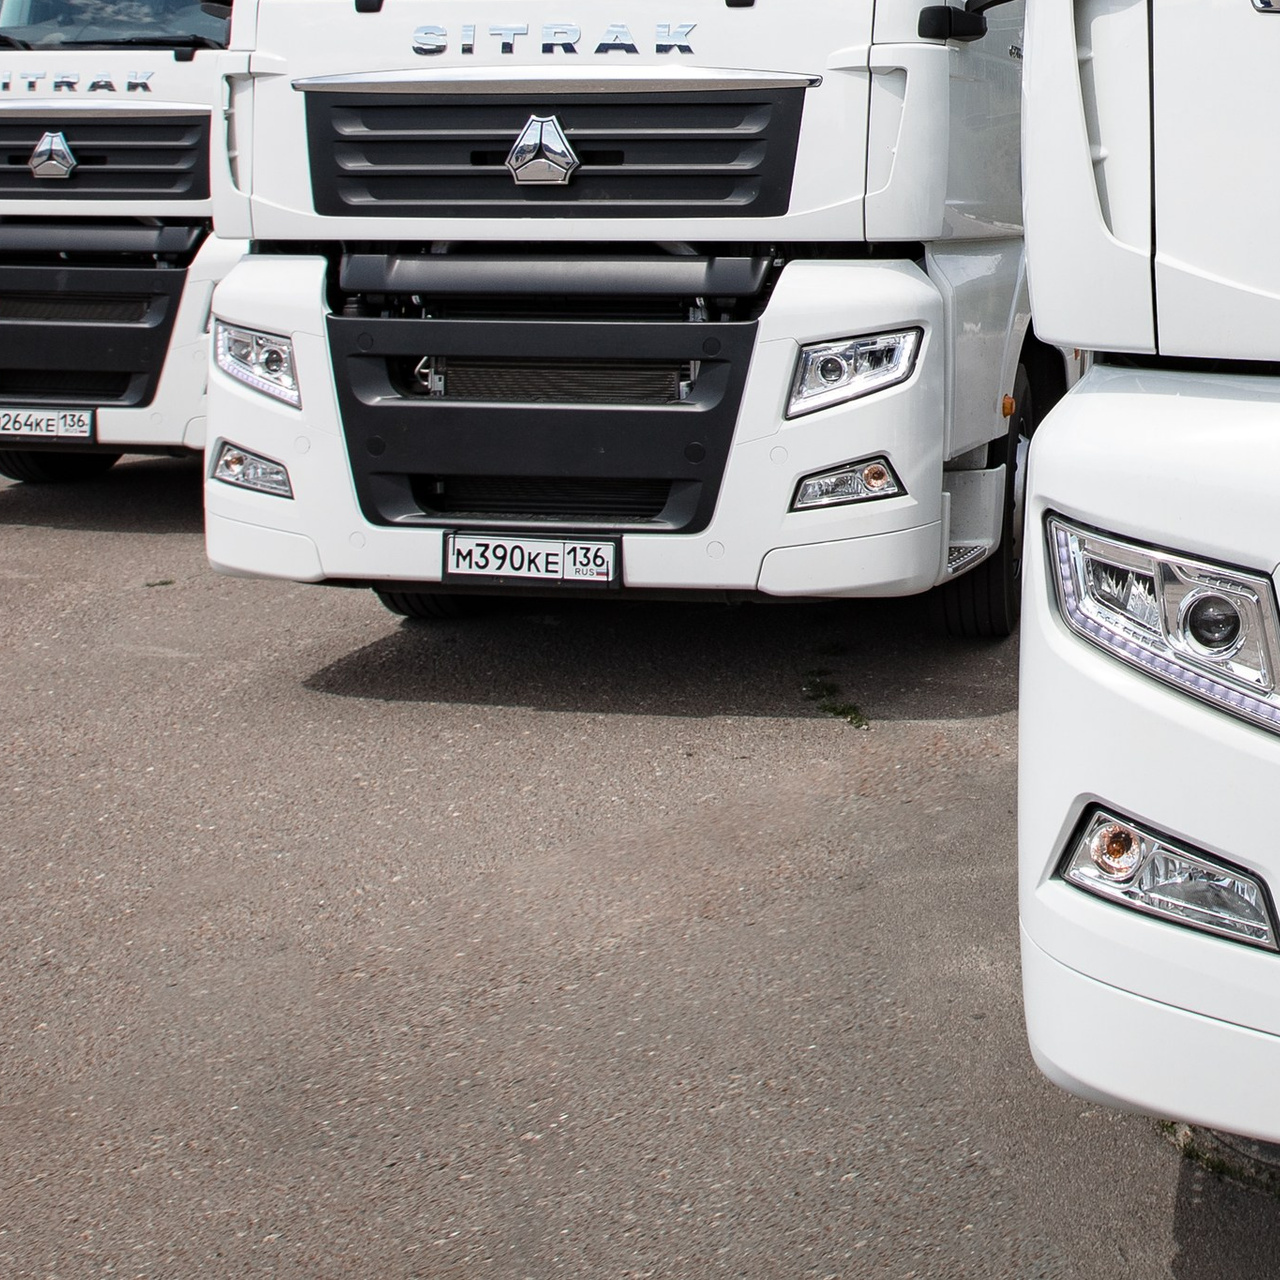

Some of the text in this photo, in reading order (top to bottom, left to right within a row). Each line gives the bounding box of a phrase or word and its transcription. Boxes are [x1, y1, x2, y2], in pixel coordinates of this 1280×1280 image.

[411, 23, 698, 57] SITRAK
[0, 413, 86, 432] 264КЕ 136
[566, 546, 606, 568] 136
[574, 568, 595, 576] RUS
